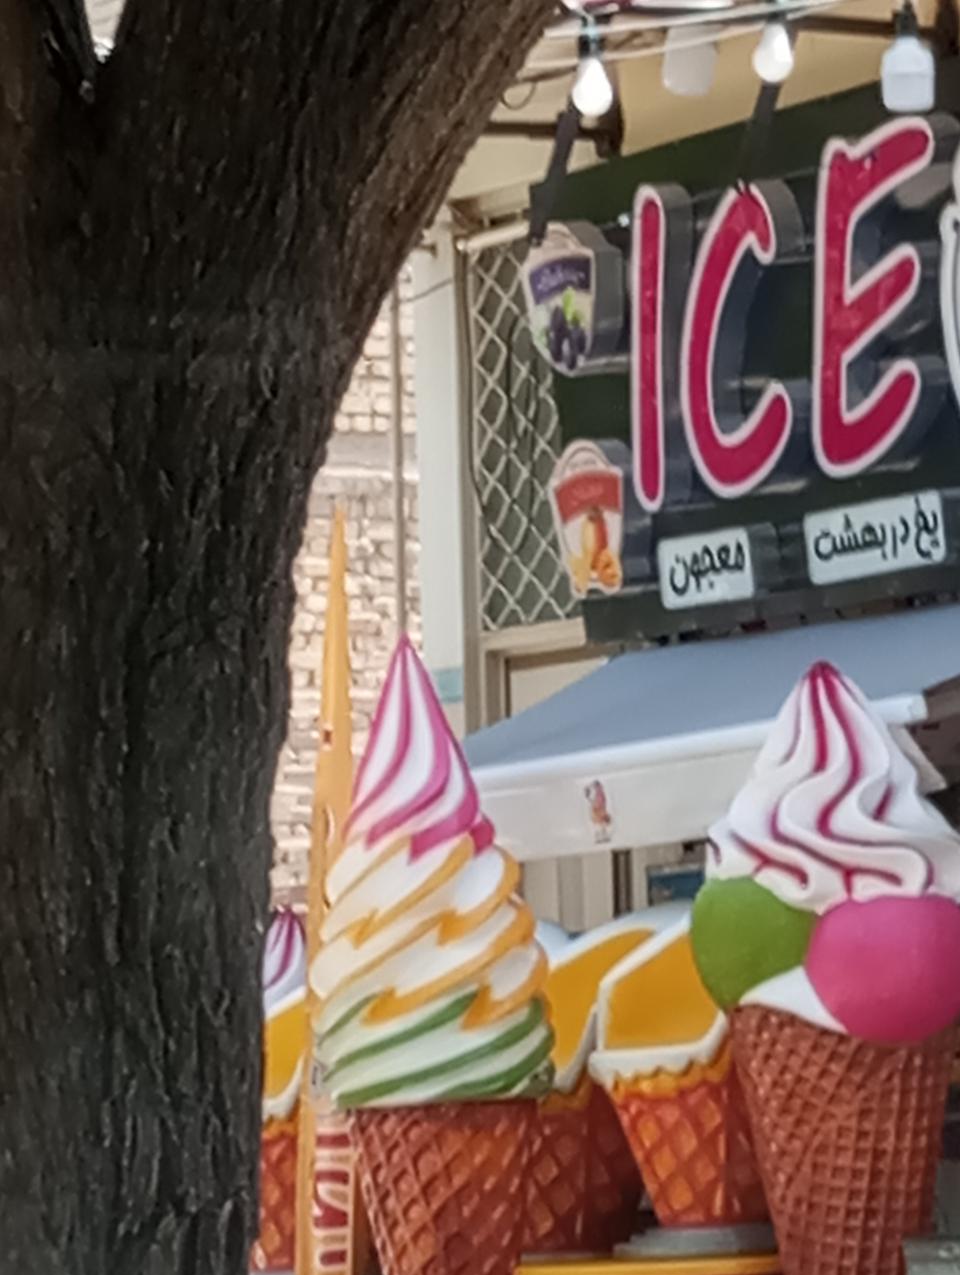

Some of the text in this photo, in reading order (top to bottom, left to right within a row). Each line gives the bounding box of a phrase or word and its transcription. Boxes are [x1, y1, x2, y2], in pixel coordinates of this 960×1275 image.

[632, 117, 936, 513] ICE
[813, 496, 940, 563] یخ در بهشت
[668, 536, 746, 597] معجون
